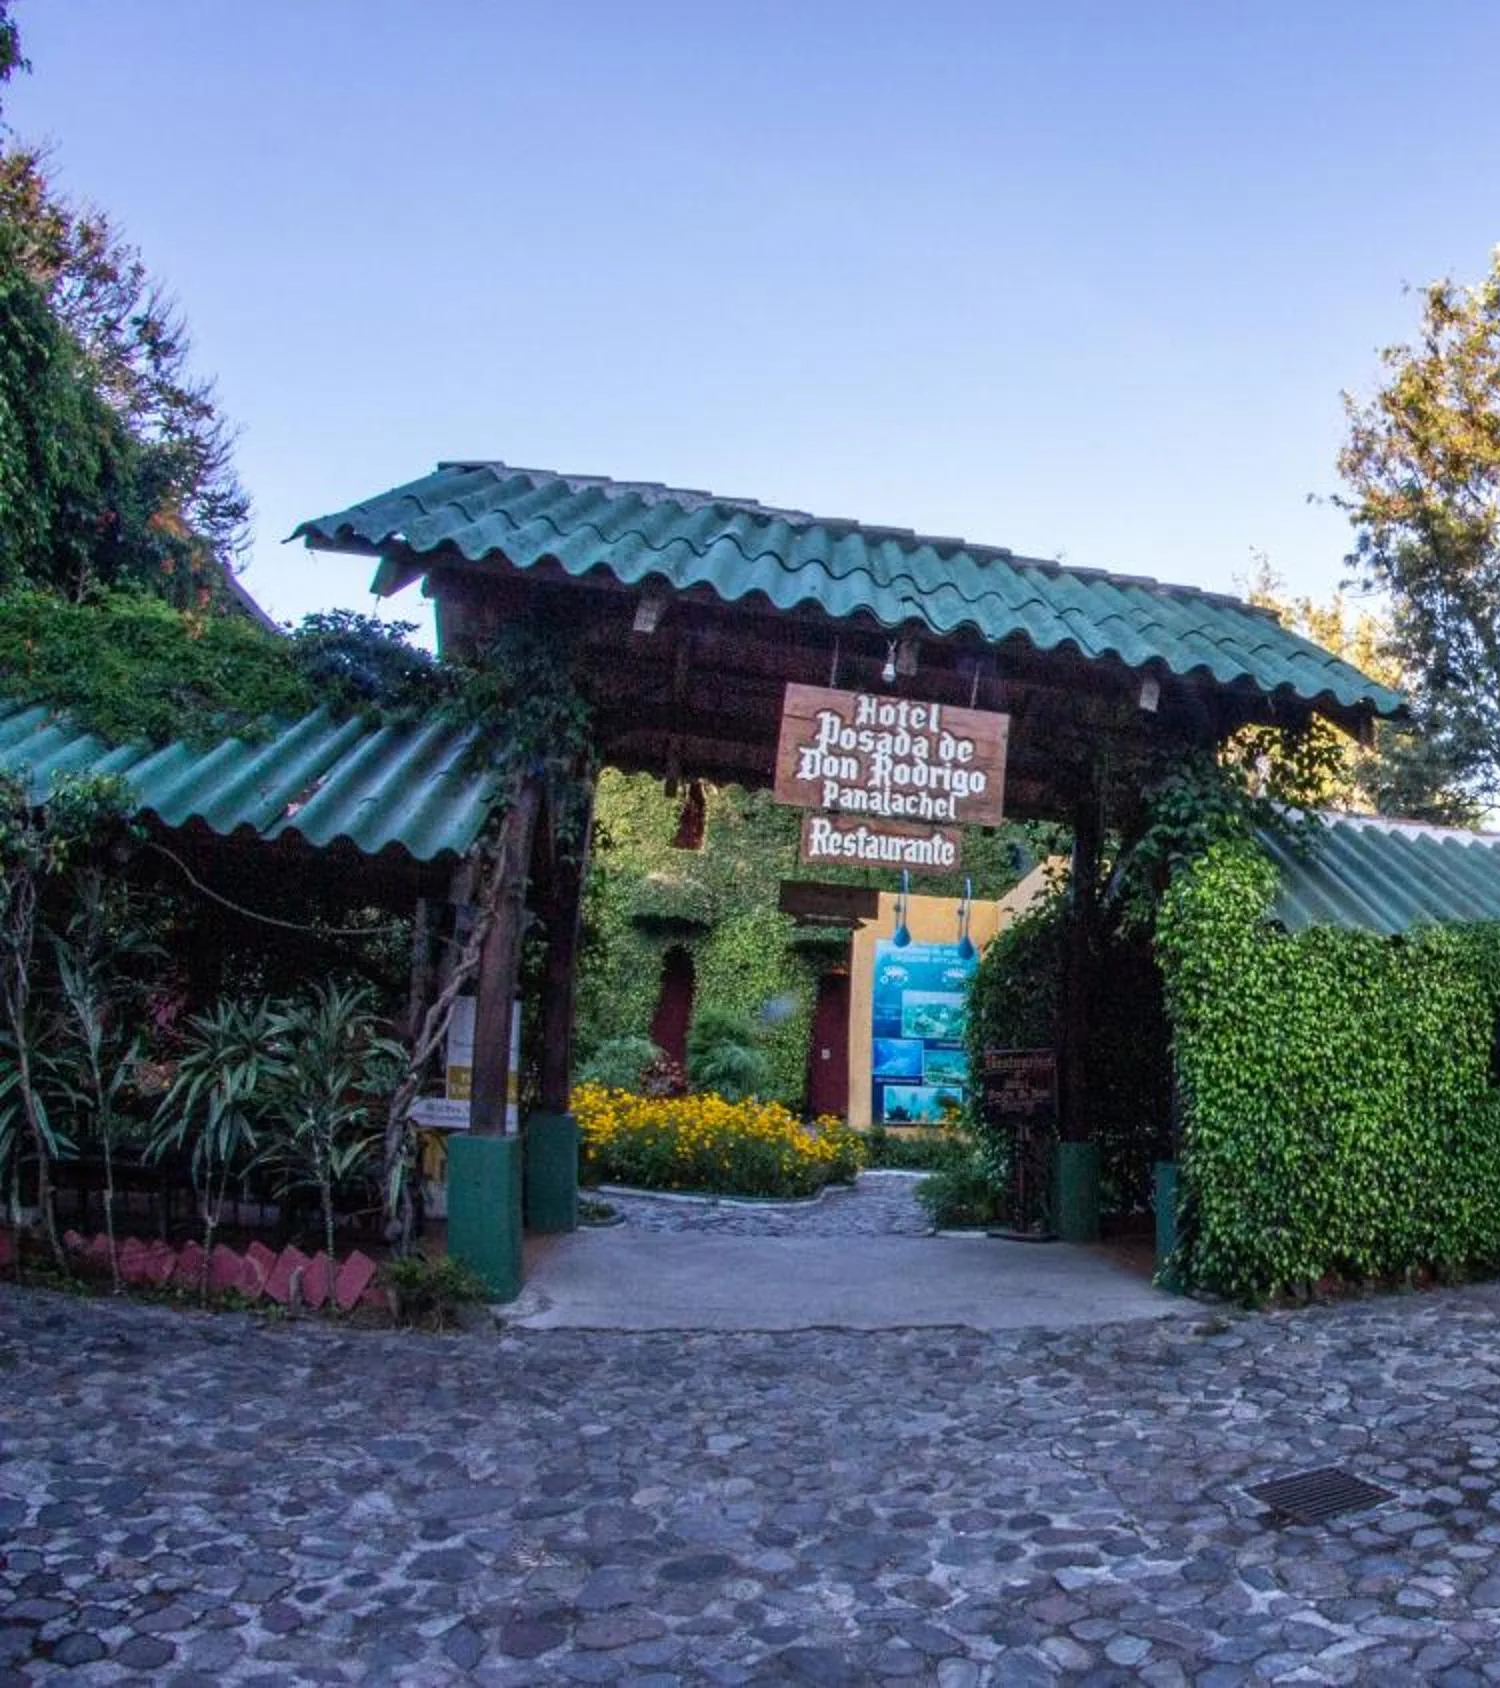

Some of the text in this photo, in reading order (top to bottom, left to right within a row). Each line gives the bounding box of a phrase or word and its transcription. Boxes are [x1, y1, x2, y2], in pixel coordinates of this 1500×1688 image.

[815, 711, 974, 763] Posada de
[855, 695, 940, 732] Hotel
[796, 746, 986, 797] Don Rodrigo
[822, 780, 956, 819] Panajachel
[809, 818, 955, 865] Restaurante
